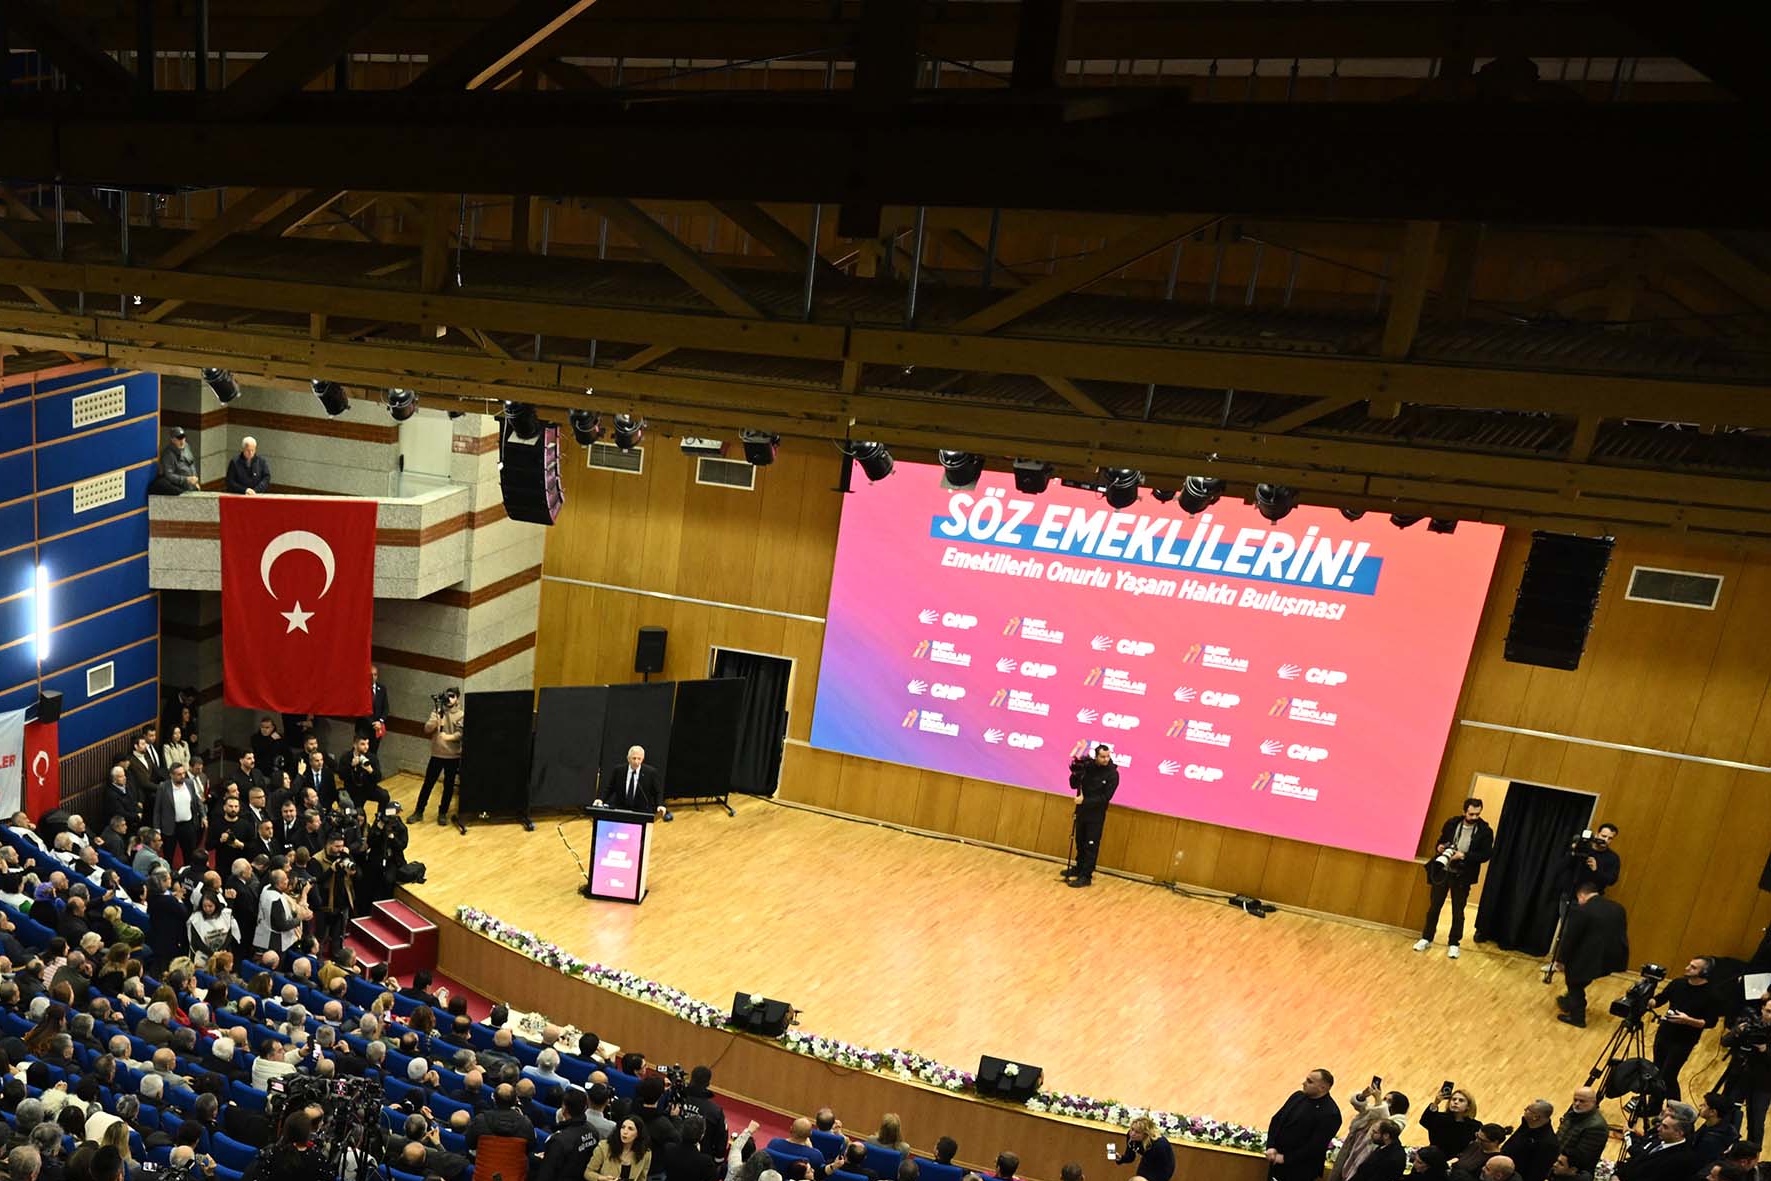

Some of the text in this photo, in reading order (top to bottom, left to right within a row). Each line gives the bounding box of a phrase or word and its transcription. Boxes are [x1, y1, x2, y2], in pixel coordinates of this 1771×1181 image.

[940, 487, 1371, 588] SÖZ EMEKLİLERİN!
[941, 547, 1346, 620] Emeklilerin Onurlu Yaşam Hakkı Buluşması
